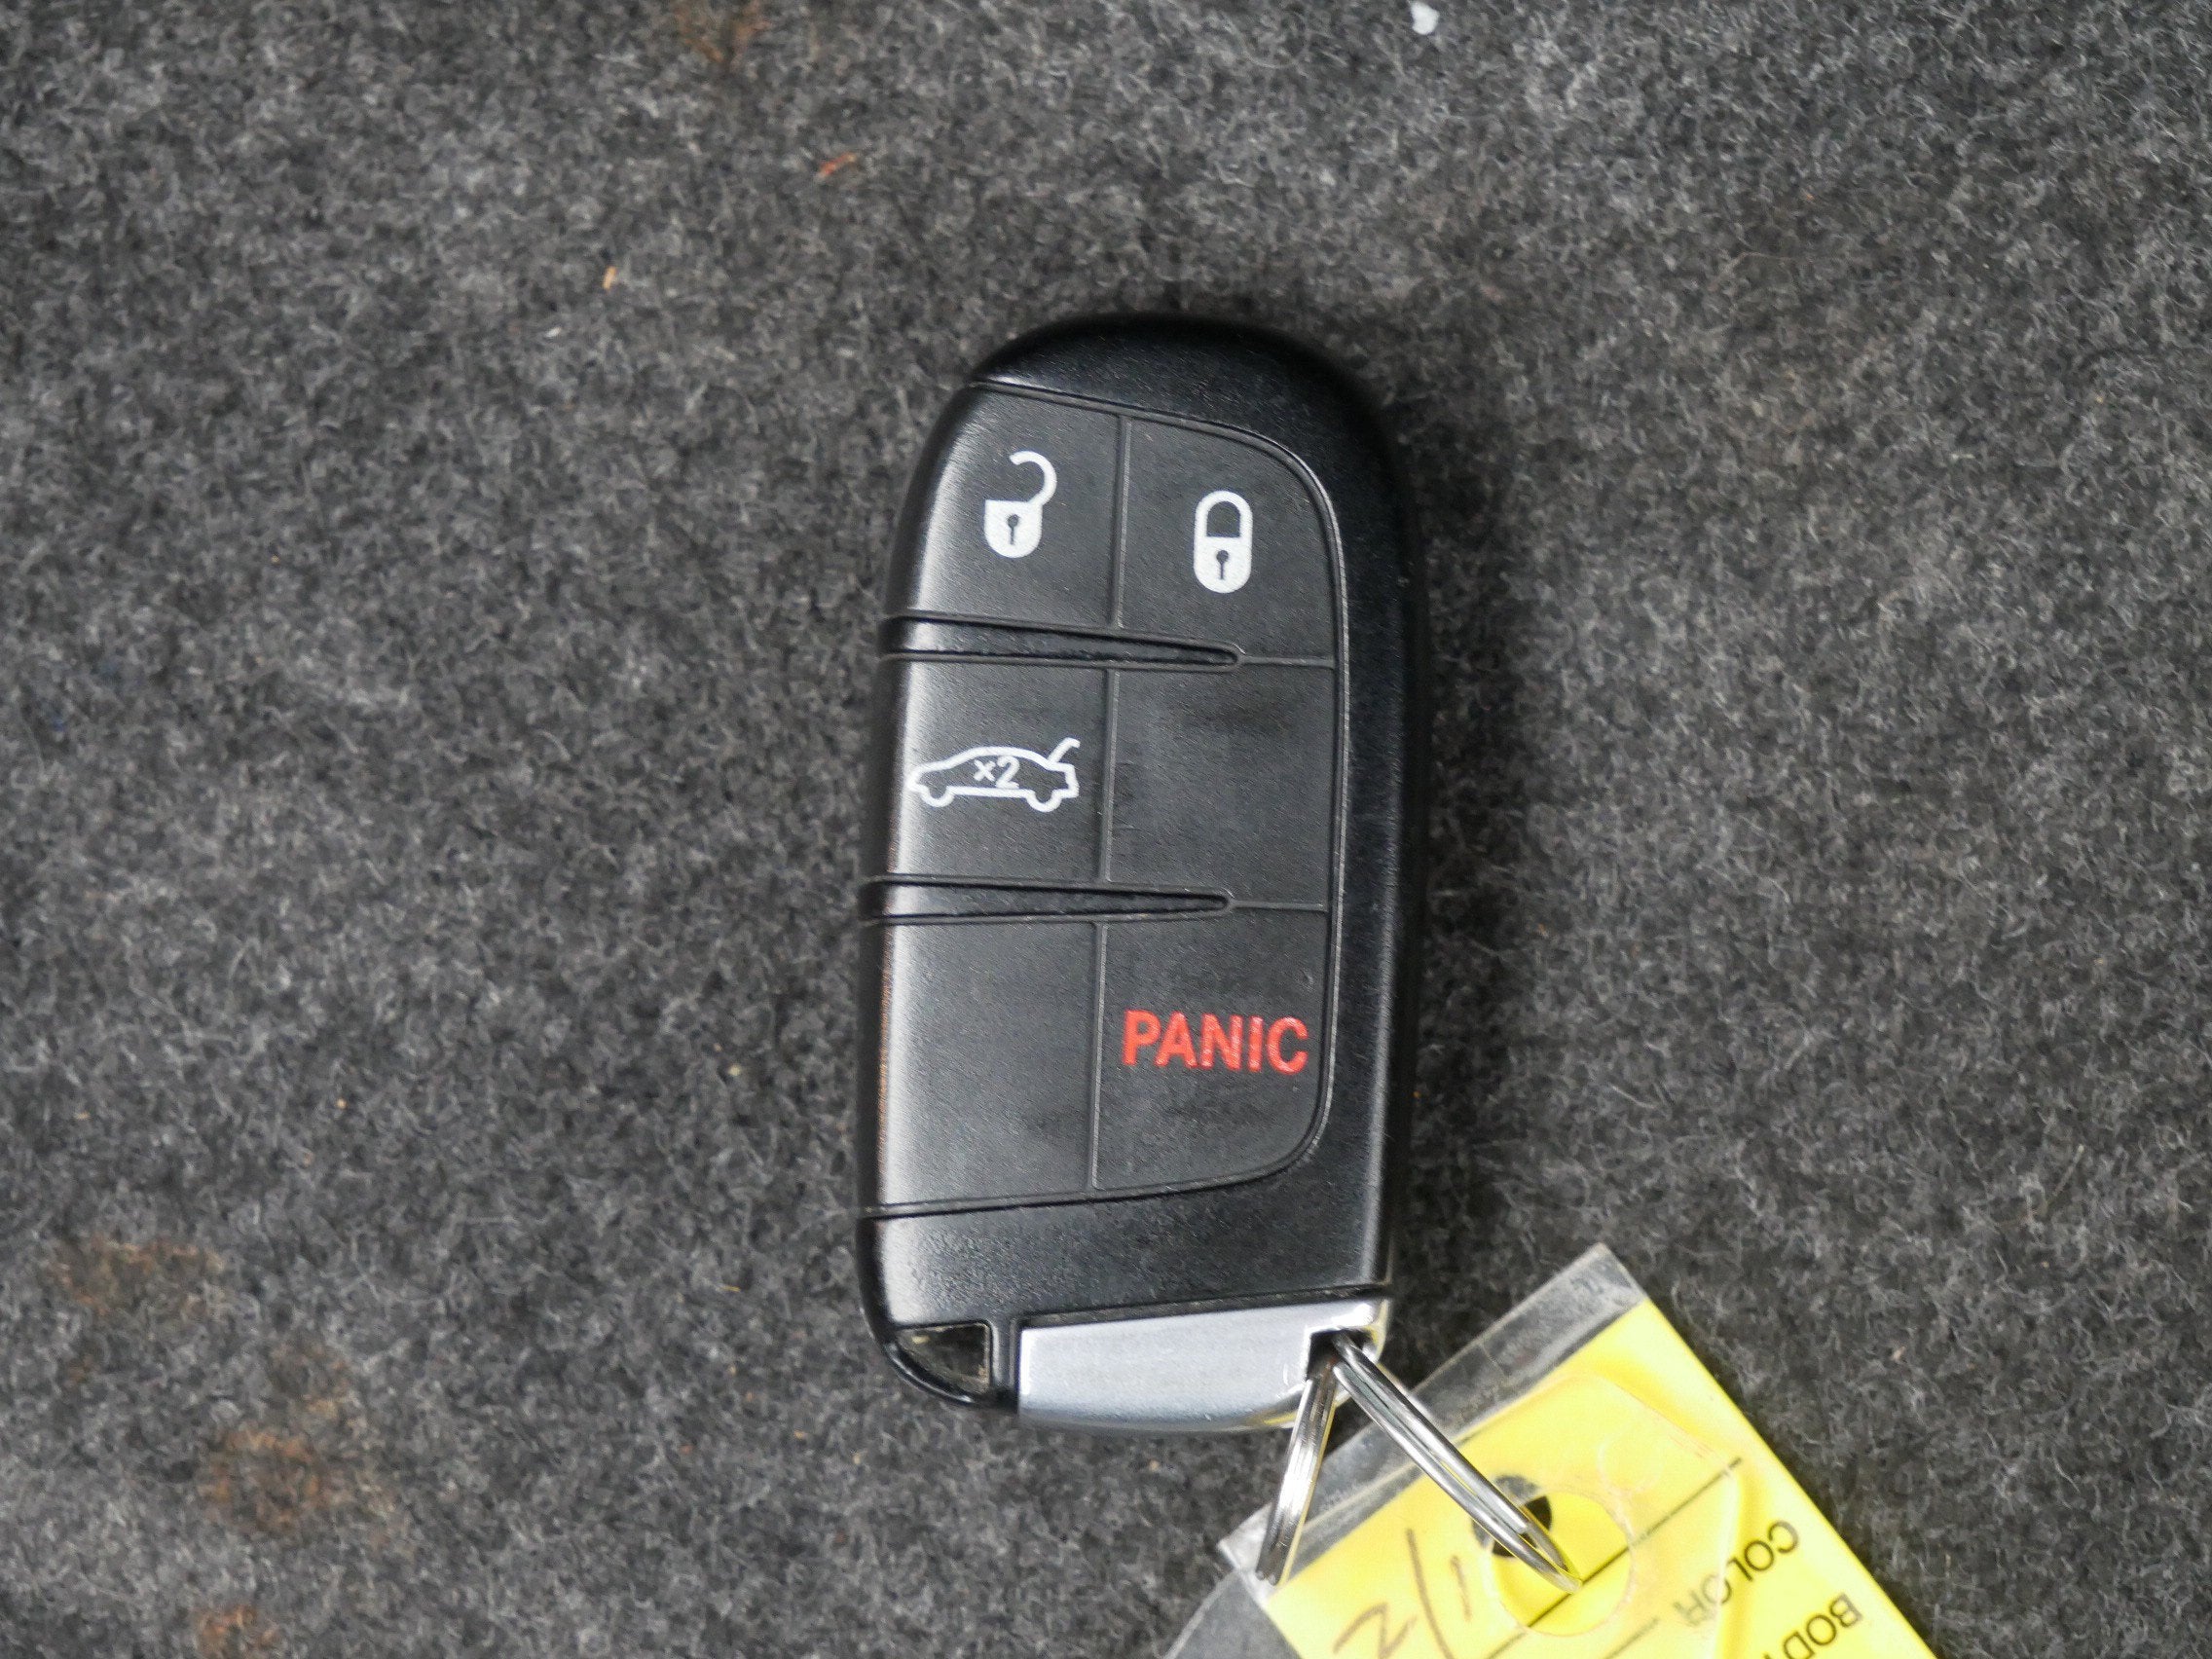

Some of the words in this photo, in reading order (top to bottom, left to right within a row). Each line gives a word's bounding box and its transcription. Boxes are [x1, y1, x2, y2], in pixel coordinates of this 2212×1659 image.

[1123, 1009, 1309, 1076] PANIC
[1673, 1520, 1799, 1628] COLOR
[1762, 1593, 1863, 1659] BOD
